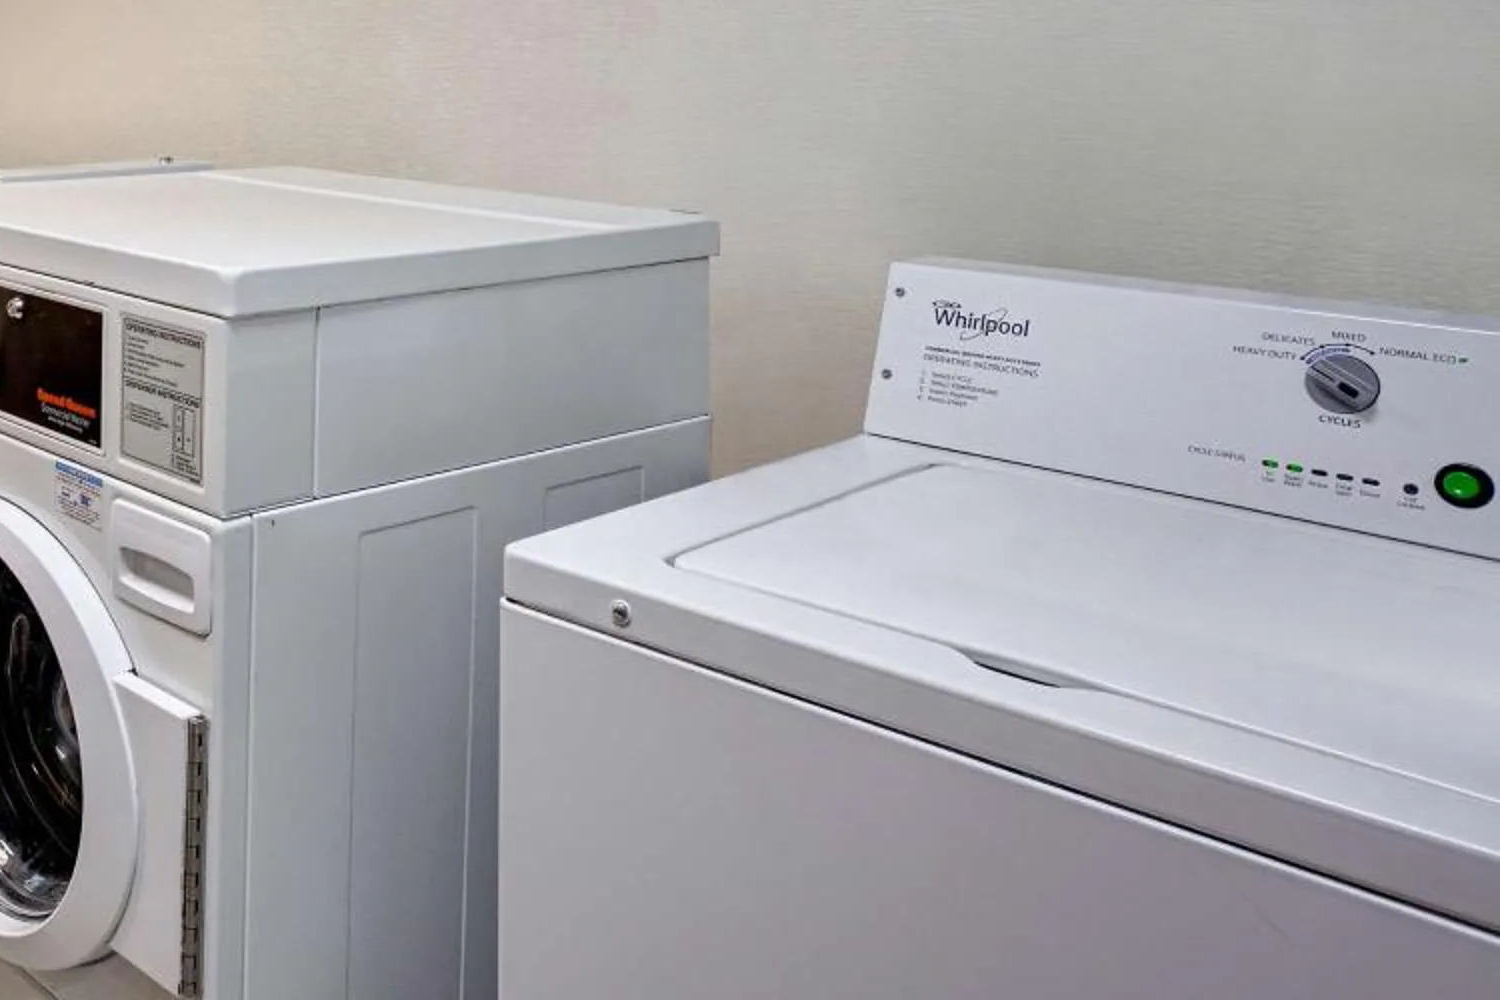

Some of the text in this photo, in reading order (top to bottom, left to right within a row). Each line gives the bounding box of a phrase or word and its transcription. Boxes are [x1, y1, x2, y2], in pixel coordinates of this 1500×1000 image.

[935, 308, 1029, 336] Whirlpool
[1262, 332, 1316, 346] DELICATES
[1331, 331, 1366, 342] MIXED
[1233, 345, 1296, 361] HEAVY DUTY
[1379, 347, 1428, 361] NORMAL
[1319, 415, 1361, 428] CYCLES
